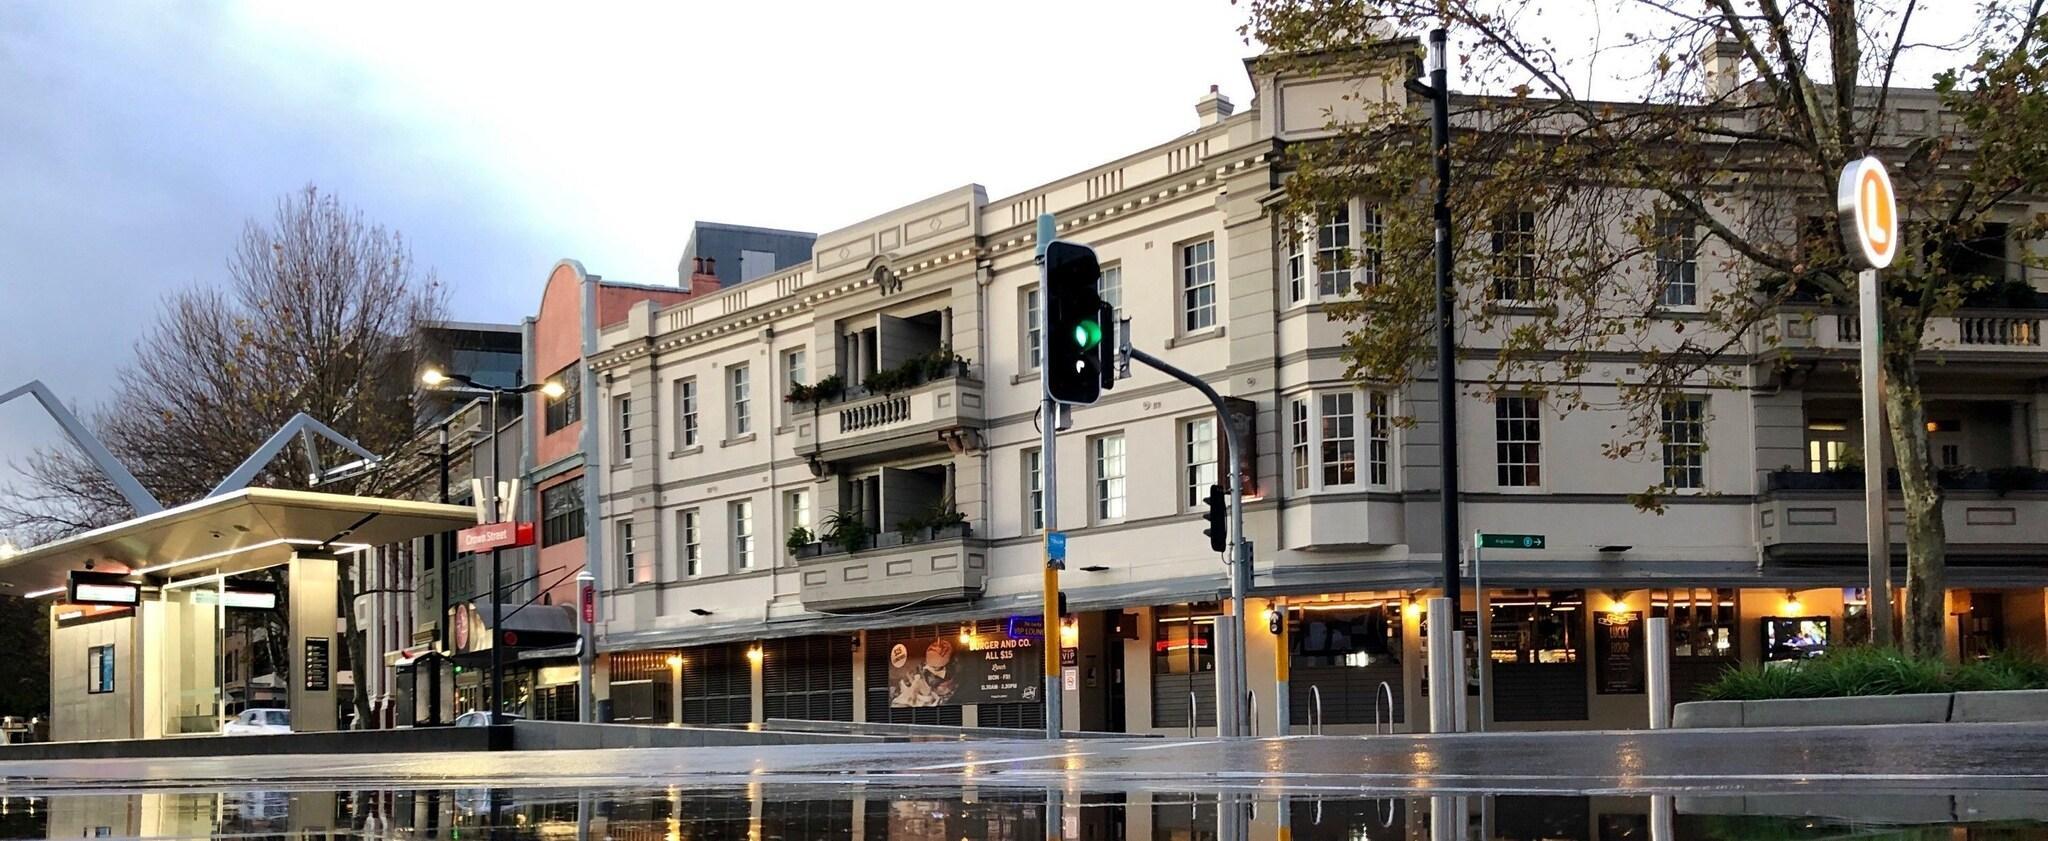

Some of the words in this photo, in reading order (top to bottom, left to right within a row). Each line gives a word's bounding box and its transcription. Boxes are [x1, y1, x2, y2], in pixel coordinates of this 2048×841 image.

[1867, 179, 1886, 243] L
[486, 529, 507, 540] Street
[1025, 626, 1044, 636] LOUN
[969, 640, 999, 651] BURGER
[1000, 640, 1017, 649] AND
[1018, 638, 1031, 647] CO.
[985, 651, 999, 660] ALL
[1000, 650, 1013, 659] $15
[1062, 652, 1075, 660] VIP
